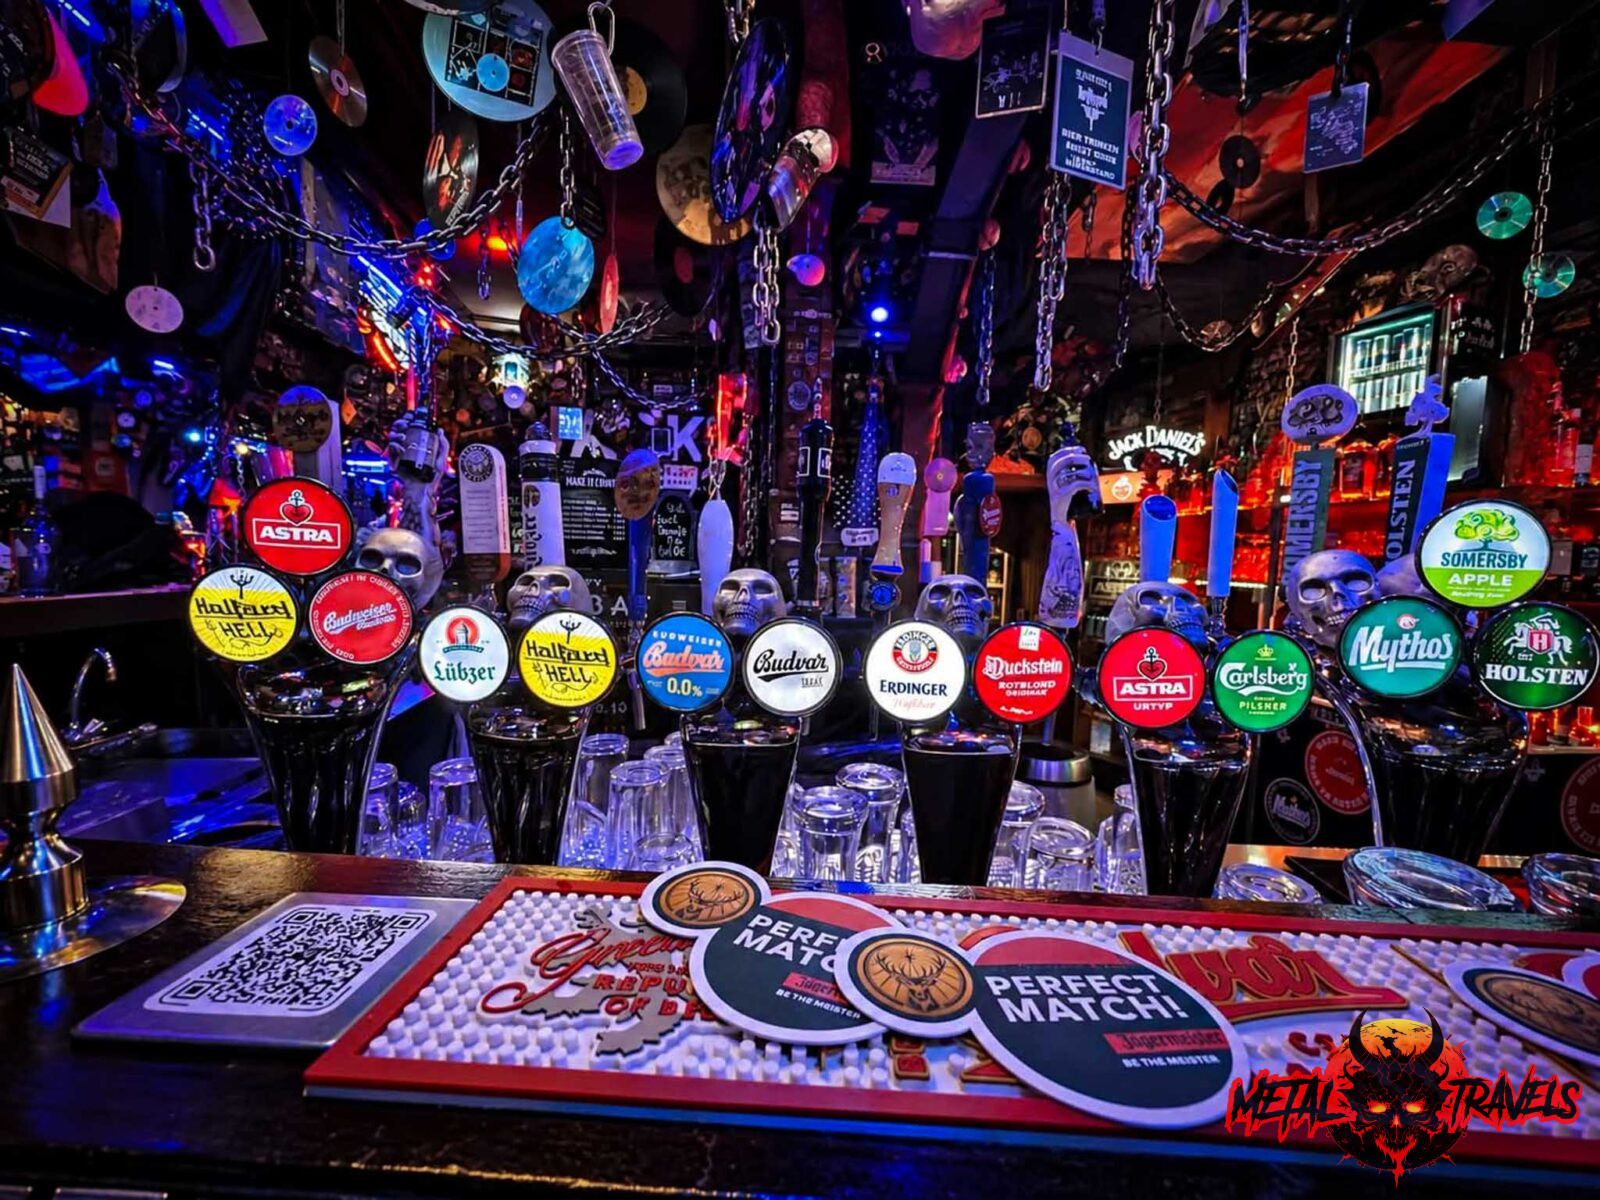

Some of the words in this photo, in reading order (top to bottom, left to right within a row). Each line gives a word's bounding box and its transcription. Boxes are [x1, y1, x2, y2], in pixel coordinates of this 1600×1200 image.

[1108, 431, 1145, 460] JACK
[1145, 425, 1207, 456] DANIEL'S
[1385, 460, 1416, 561] OLSTEN
[259, 525, 334, 543] ASTRA
[1440, 551, 1528, 569] SOMERSBY
[1448, 573, 1514, 587] APPLE
[323, 602, 397, 635] Budweiser
[219, 621, 268, 638] HELL
[652, 630, 722, 648] BUDWEISER
[1348, 625, 1454, 673] Mythos
[434, 660, 496, 685] Lübzer
[544, 663, 592, 683] HELL
[753, 648, 829, 683] Budvar
[982, 655, 1063, 680] Duckstein
[1485, 663, 1589, 686] HOLSTEN
[667, 677, 703, 697] 0.0%
[880, 679, 948, 697] ERDINGER
[998, 680, 1057, 689] ROTBLOND
[1120, 682, 1187, 695] ASTRA
[1219, 662, 1309, 697] Carlsberg
[1133, 702, 1173, 711] URTYP
[1239, 701, 1287, 711] PILSNER
[748, 914, 844, 948] PERF
[592, 974, 689, 998] REPU
[984, 974, 1156, 996] PERFECT
[813, 1000, 861, 1019] MEISTER
[997, 996, 1189, 1023] MATCH!
[1121, 1030, 1223, 1050] Jägermeister
[1122, 1057, 1142, 1068] BE
[1142, 1056, 1167, 1067] THE
[1168, 1053, 1220, 1066] MEISTER
